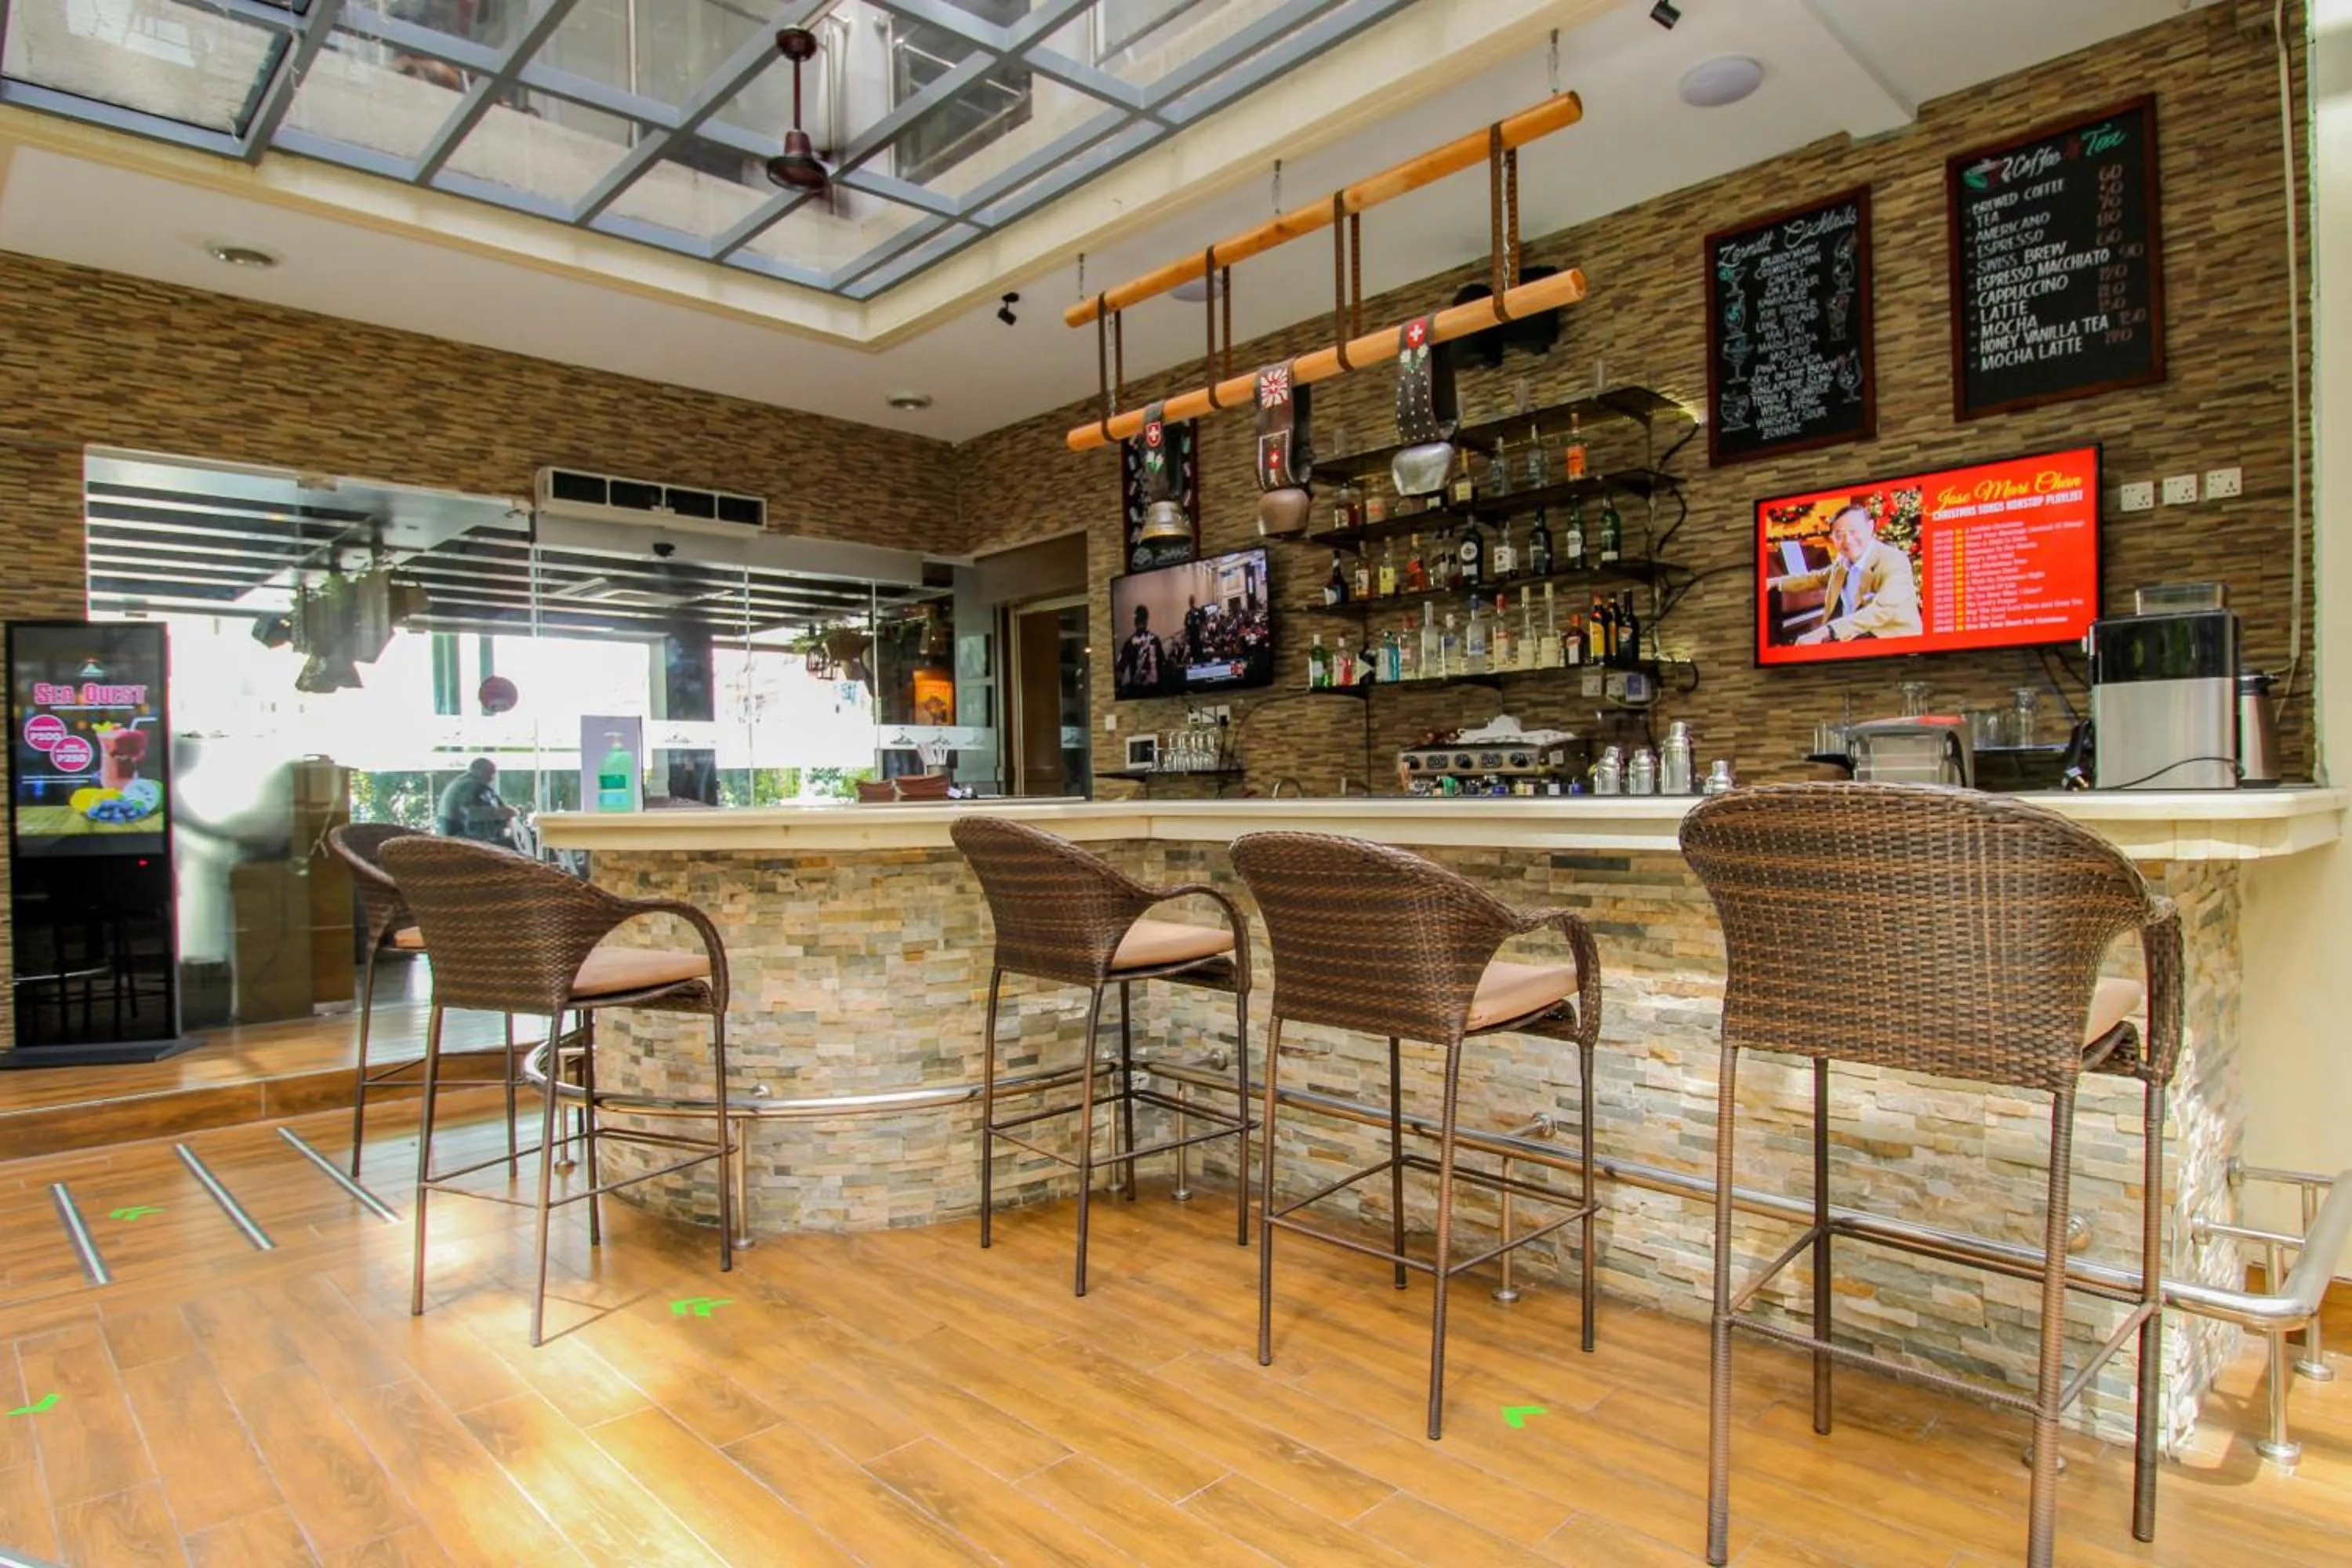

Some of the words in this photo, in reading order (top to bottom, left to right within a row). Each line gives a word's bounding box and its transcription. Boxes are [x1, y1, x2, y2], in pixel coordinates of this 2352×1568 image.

[1975, 211, 2000, 227] TEA
[1975, 212, 2050, 242] AMERICANO
[1977, 230, 2045, 259] ESPRESSO
[1977, 252, 2017, 274] SWISS
[2024, 240, 2068, 264] BREW
[1976, 266, 2034, 292] ESPRESSO
[2036, 248, 2111, 278] MACCHIATO
[1977, 274, 2069, 307] CAPPUCCINO
[1980, 299, 2029, 324] LATTE
[1981, 314, 2039, 339] MOCHA
[1980, 335, 2020, 355] HONEY
[2024, 321, 2078, 345] VANILLA
[2082, 314, 2110, 333] TEA
[1981, 347, 2035, 372] MOCHA
[2038, 336, 2084, 360] LATTE
[1973, 478, 2030, 502] Mari
[2034, 470, 2082, 494] Chan
